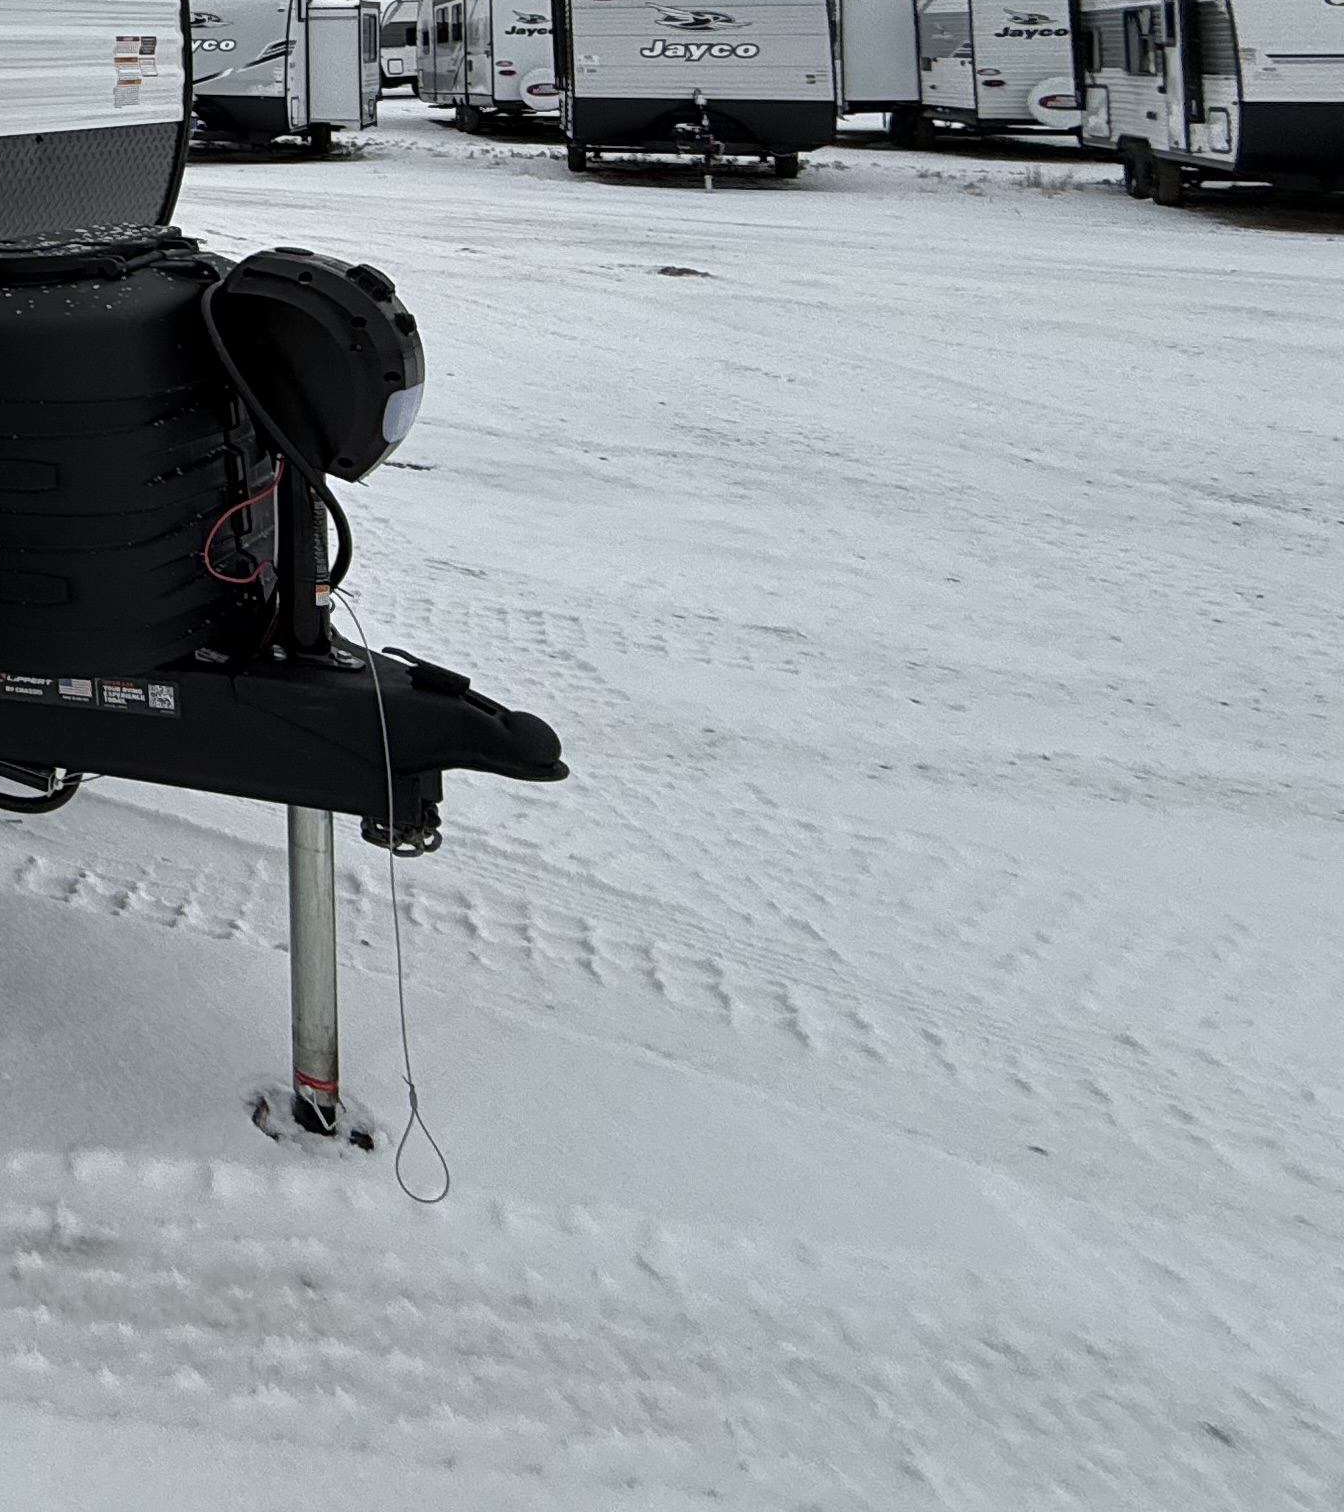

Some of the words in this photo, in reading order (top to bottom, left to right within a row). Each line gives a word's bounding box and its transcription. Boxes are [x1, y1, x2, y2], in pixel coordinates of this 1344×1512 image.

[994, 26, 1070, 40] Jayco
[191, 38, 237, 54] yco
[640, 38, 760, 62] Jayco
